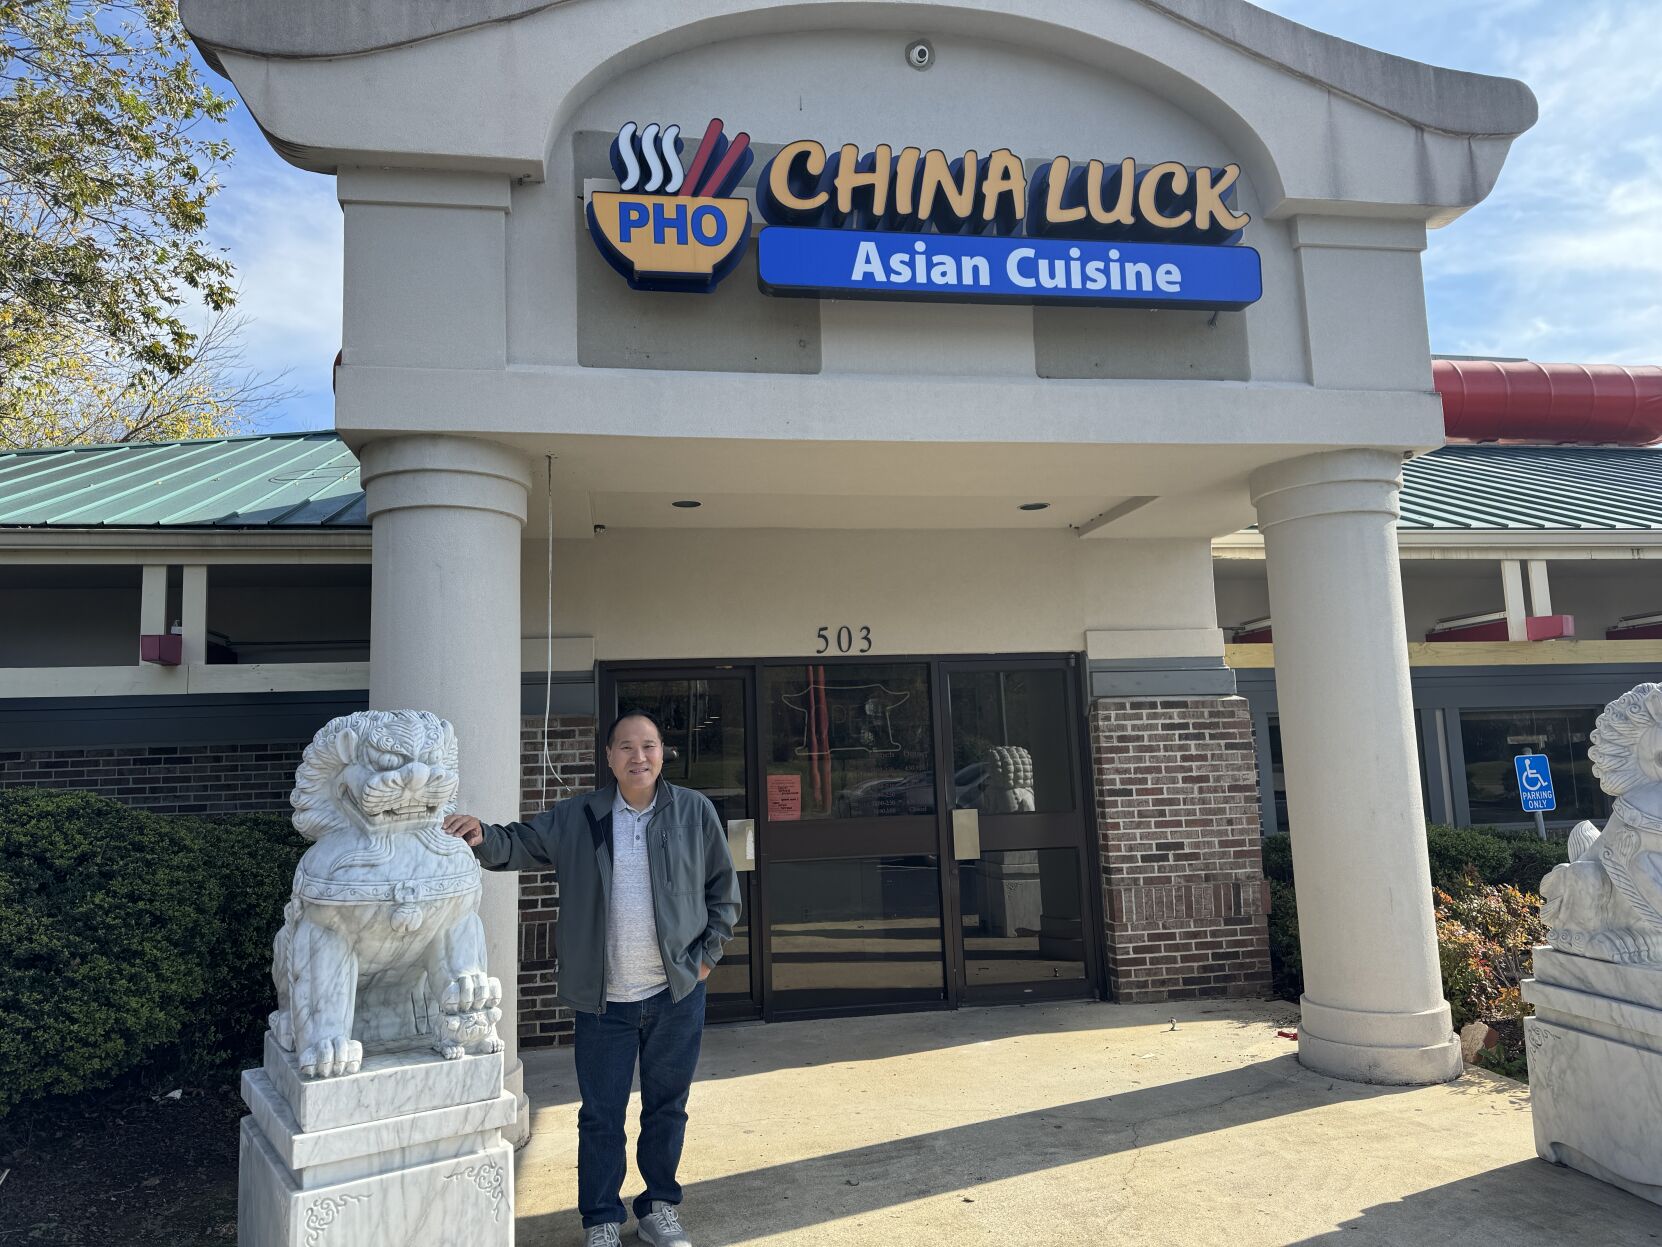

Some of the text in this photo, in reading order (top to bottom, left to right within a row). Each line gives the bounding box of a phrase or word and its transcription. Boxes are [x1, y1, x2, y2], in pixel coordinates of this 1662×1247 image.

[769, 139, 1251, 231] CHINA LUCK
[618, 201, 728, 247] PHO
[851, 241, 1182, 293] Asian Cuisine
[816, 626, 872, 654] 503
[1522, 790, 1553, 800] PARKING
[1528, 799, 1547, 808] ONLY
